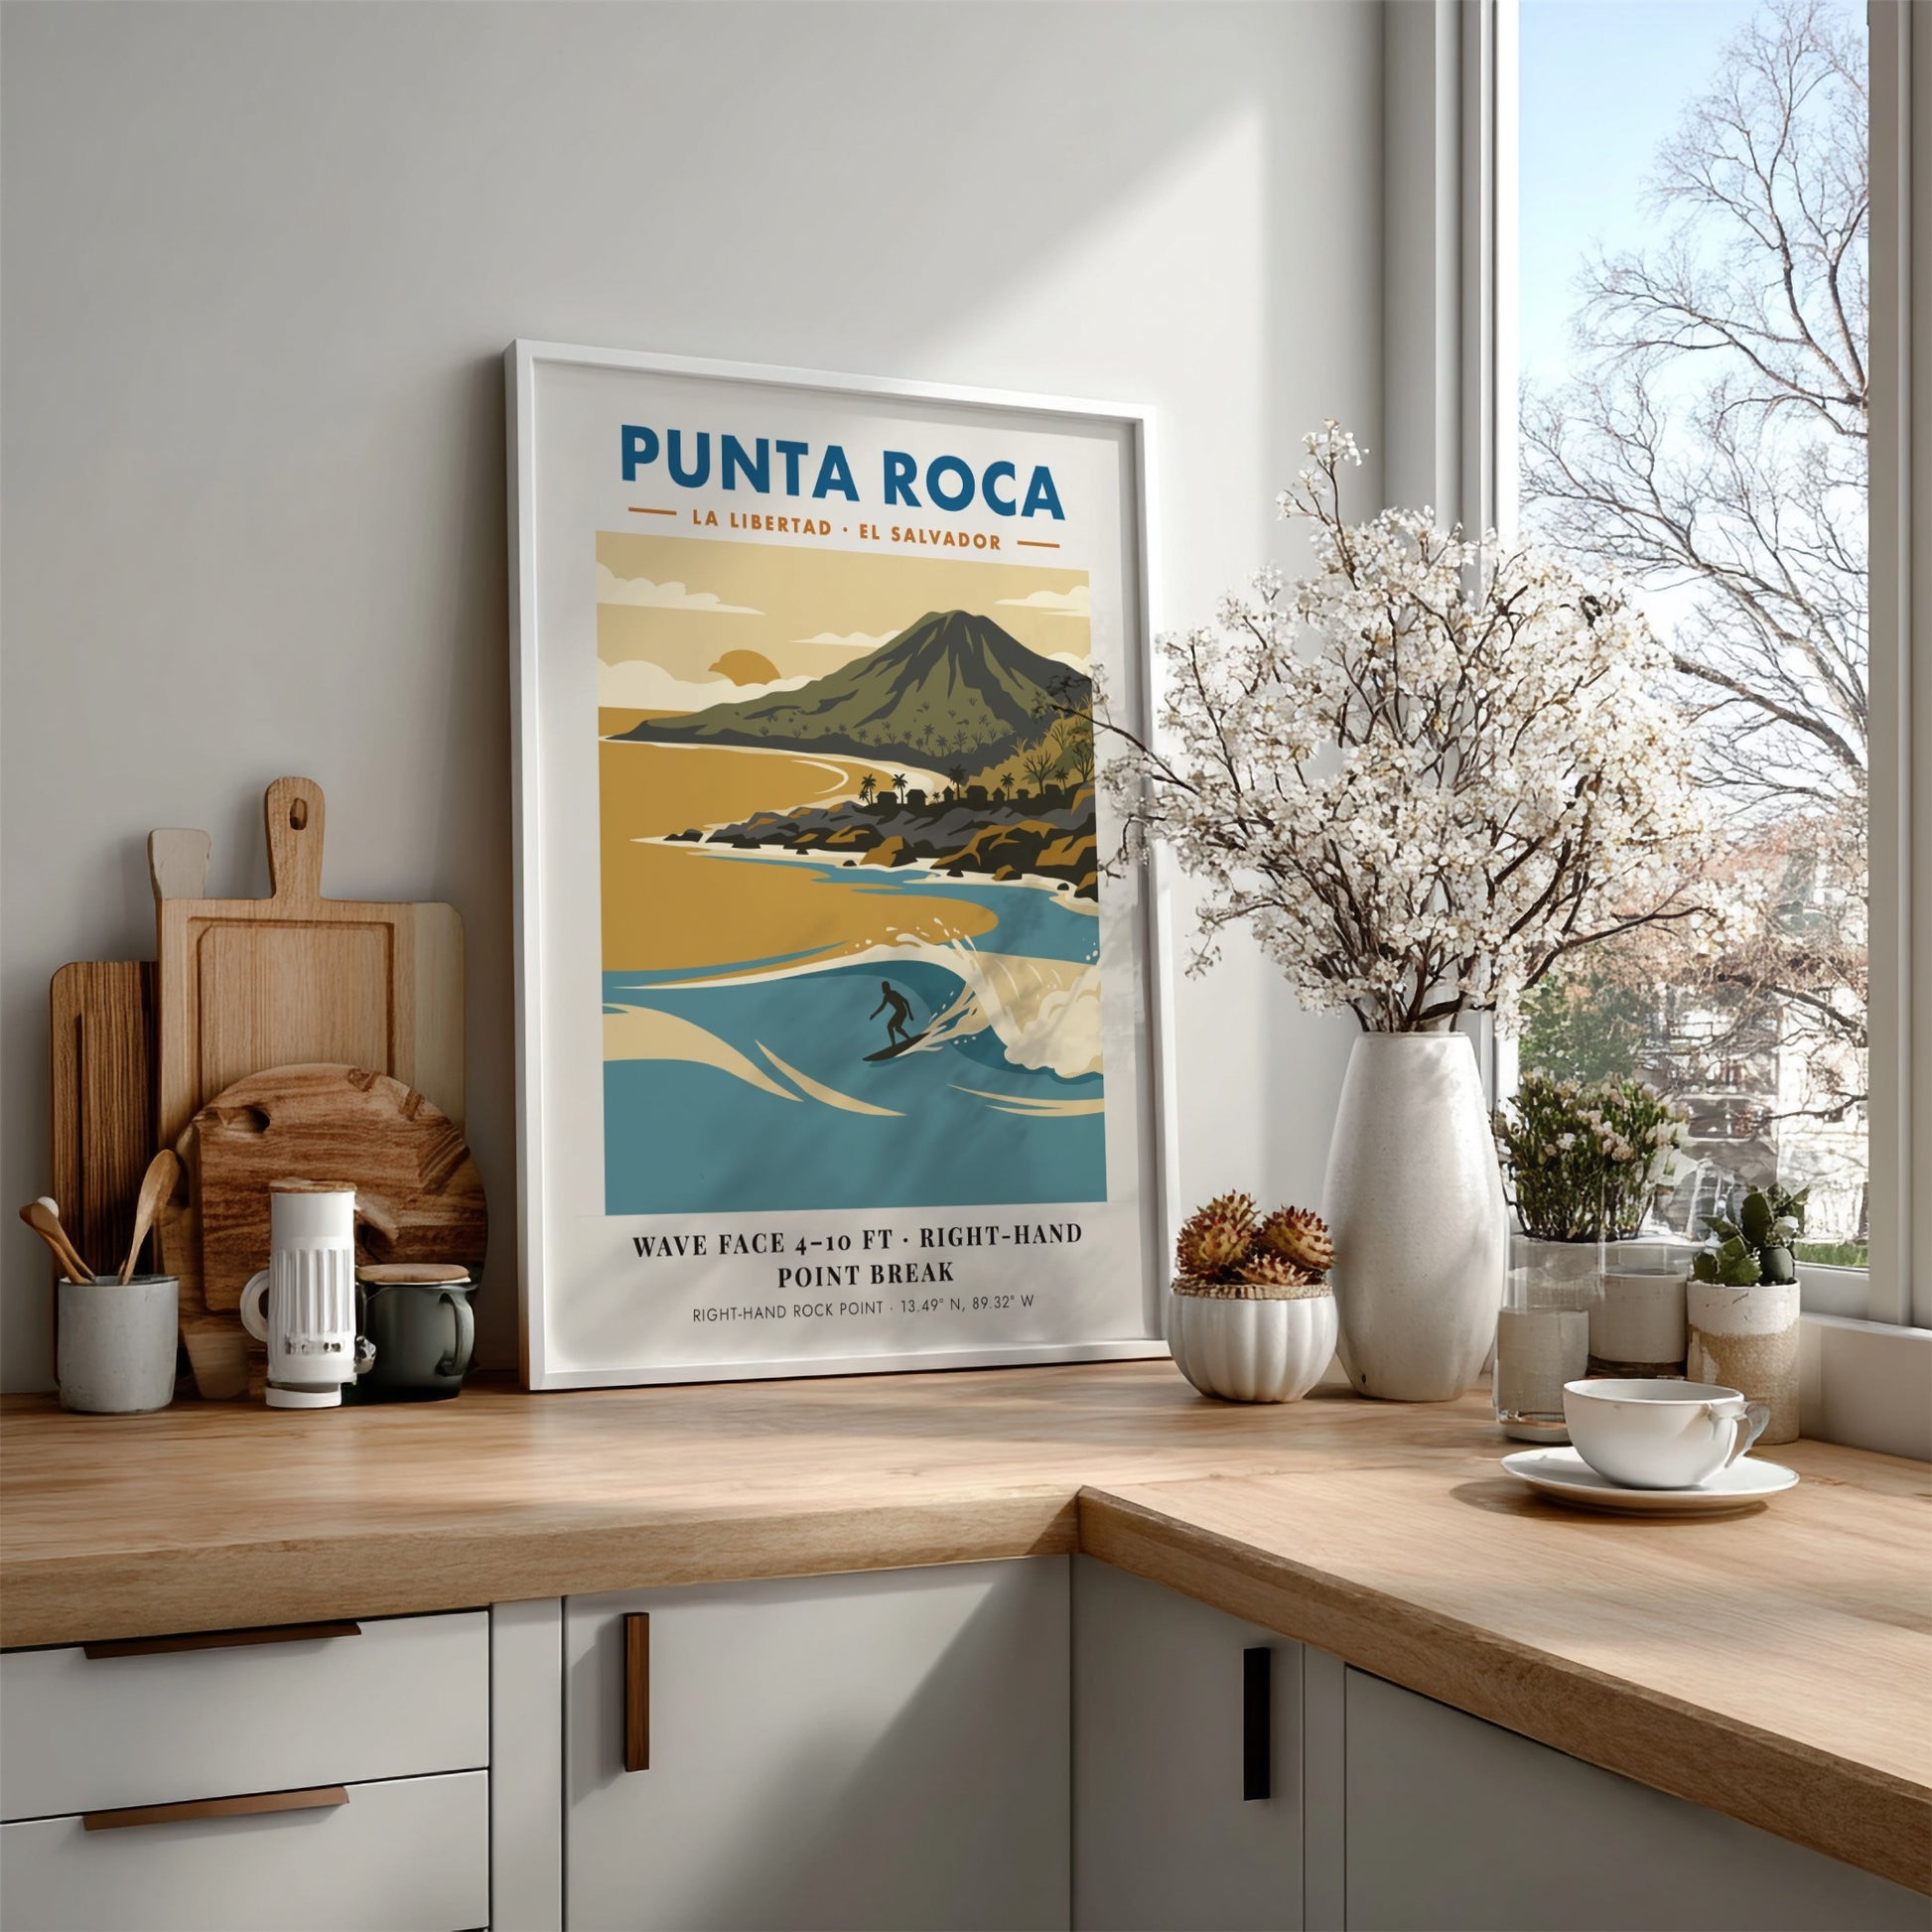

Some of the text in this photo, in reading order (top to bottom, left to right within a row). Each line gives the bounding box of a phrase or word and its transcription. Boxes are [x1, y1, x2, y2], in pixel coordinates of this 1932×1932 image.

[621, 424, 1066, 520] PUNTA ROCA
[693, 509, 1002, 551] LA LIBERTAD EL SALVADOR
[632, 1234, 708, 1258] WAVE
[718, 1231, 786, 1255] FACE
[862, 1230, 894, 1250] FT
[919, 1222, 1083, 1249] RIGHT-HAND
[777, 1261, 955, 1289] POINT BREAK
[693, 1294, 1035, 1323] RIGHT-HAND ROCK POINT 13.49° N, 89.32° W
